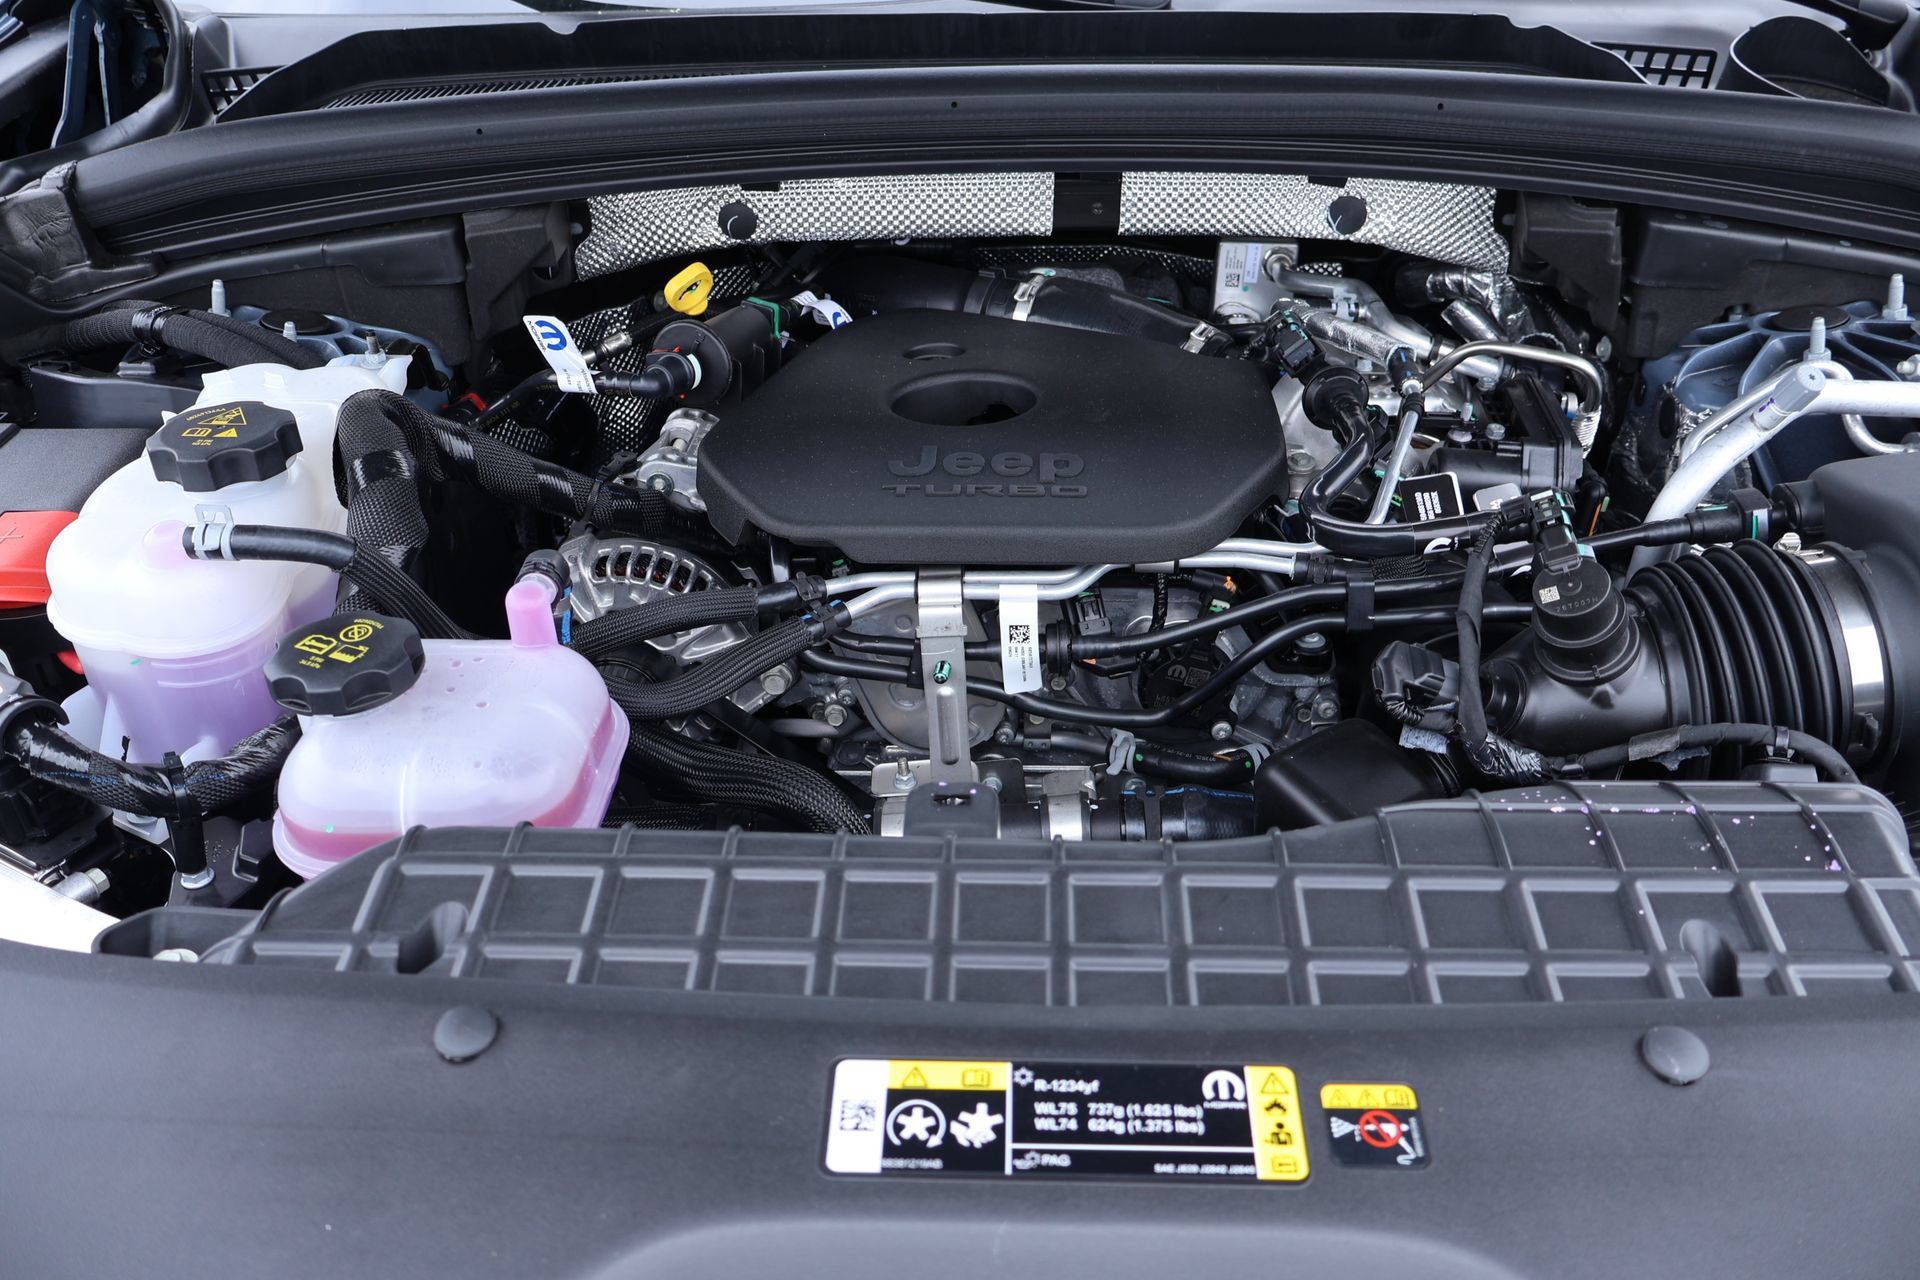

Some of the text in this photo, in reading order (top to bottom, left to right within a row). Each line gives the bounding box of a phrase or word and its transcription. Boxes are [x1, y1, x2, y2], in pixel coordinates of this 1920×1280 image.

[887, 445, 1085, 484] Jeep
[881, 484, 1089, 498] TURBO
[1033, 1079, 1101, 1095] R-1234yf
[1033, 1102, 1204, 1119] WL75 737g (1.625 lbs)
[1033, 1118, 1206, 1136] WL74 624g (1.375 lbs)
[1040, 1154, 1071, 1167] PAG
